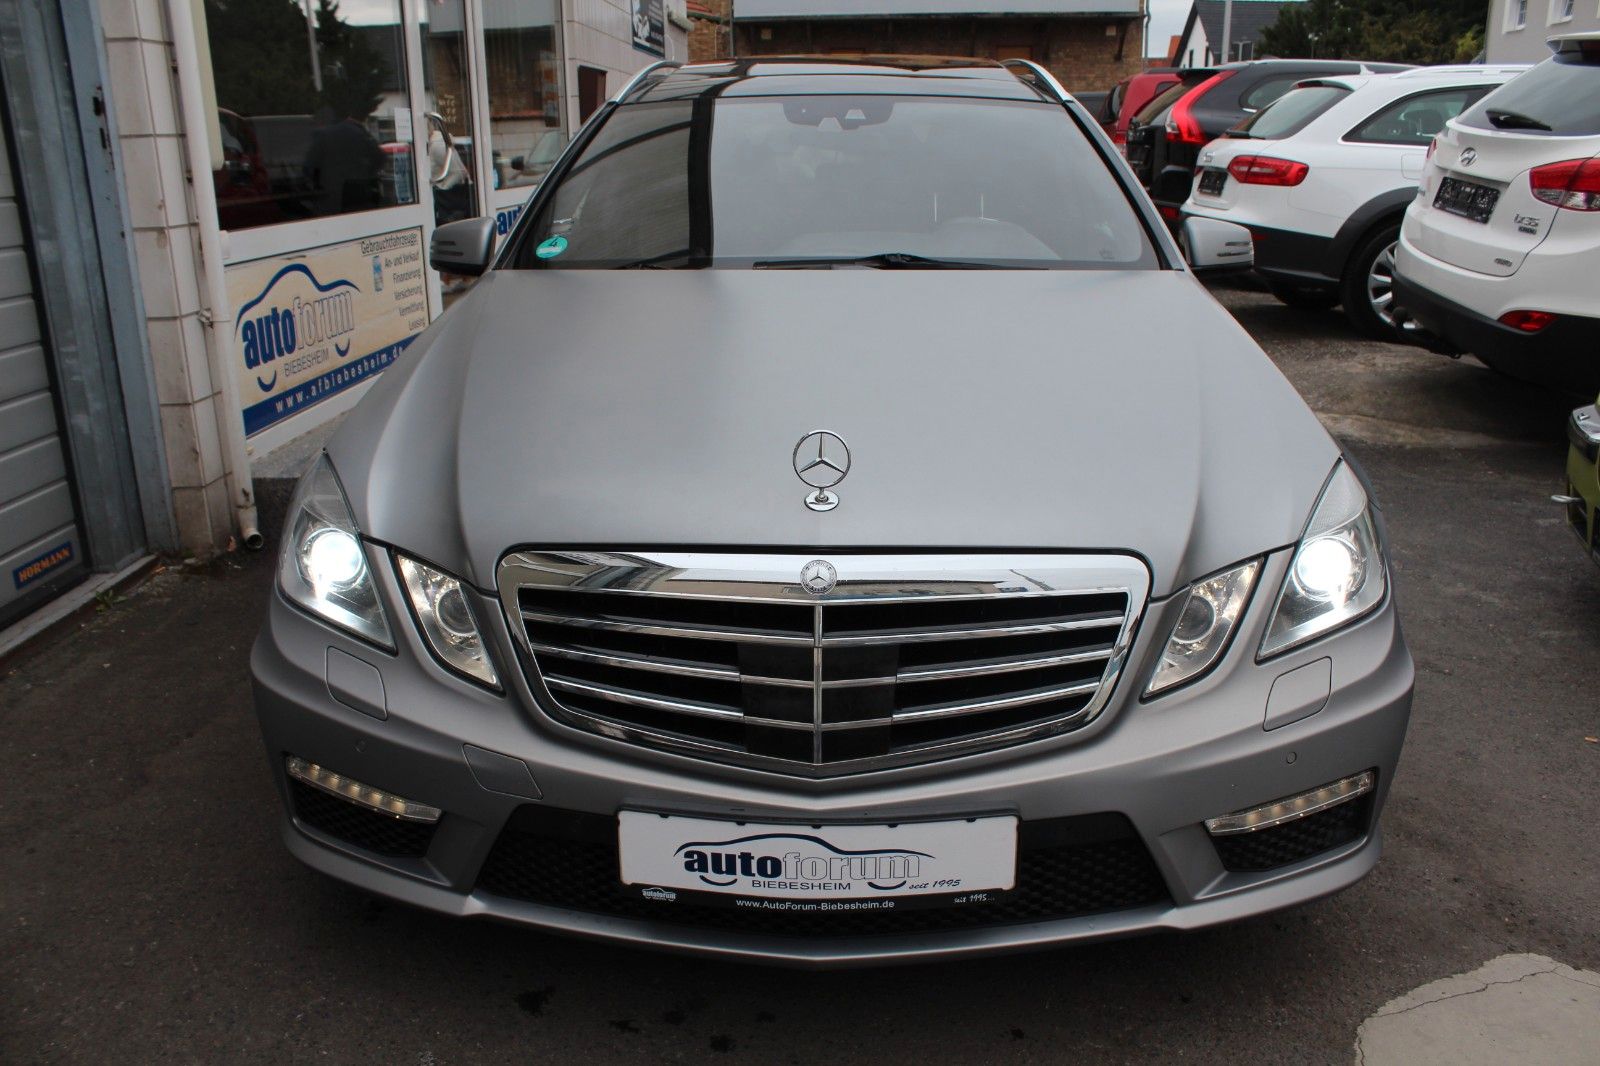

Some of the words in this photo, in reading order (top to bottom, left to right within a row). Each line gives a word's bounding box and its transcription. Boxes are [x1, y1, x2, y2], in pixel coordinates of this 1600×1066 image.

[283, 347, 330, 377] BIEBESHEIM
[751, 879, 851, 891] BIEBESHEIM
[908, 881, 930, 890] seit
[932, 878, 962, 889] 1995
[735, 898, 896, 912] www.AutoForum-Biebesheim.de
